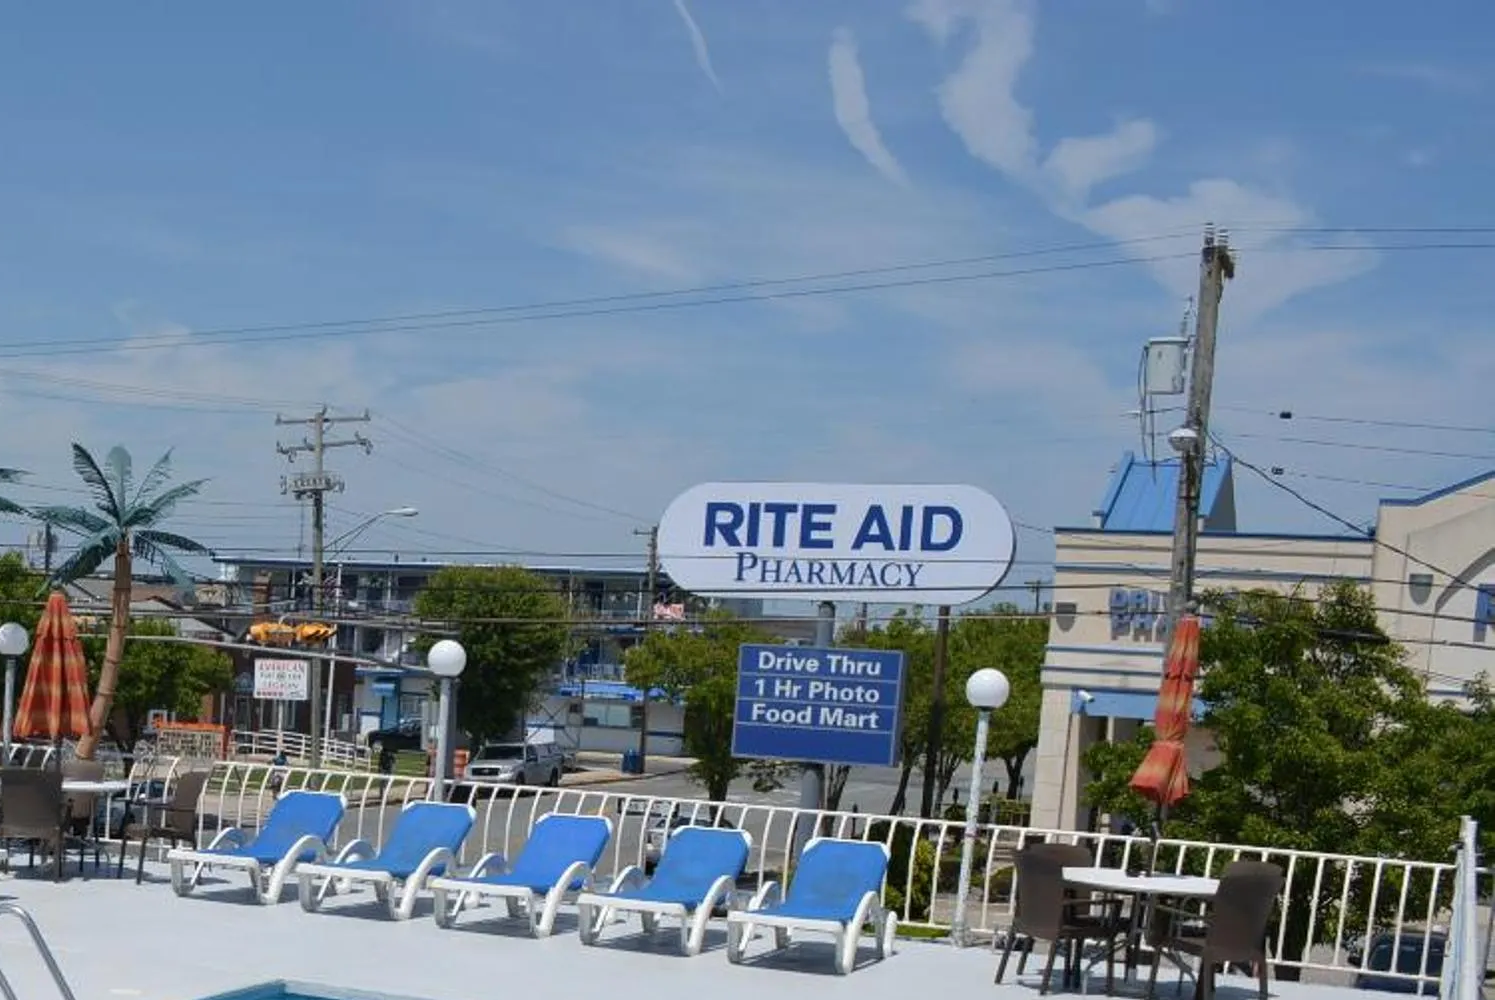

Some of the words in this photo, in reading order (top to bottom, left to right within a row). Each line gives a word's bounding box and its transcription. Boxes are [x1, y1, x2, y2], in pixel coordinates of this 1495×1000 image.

[703, 501, 837, 549] RITE
[850, 503, 964, 552] AID
[733, 551, 924, 587] PHARMACY
[758, 651, 820, 673] Drive
[827, 654, 882, 676] Thru
[755, 679, 766, 697] 1
[774, 680, 802, 699] Hr
[808, 681, 881, 703] Photo
[751, 703, 812, 724] Food
[818, 707, 880, 729] Mart
